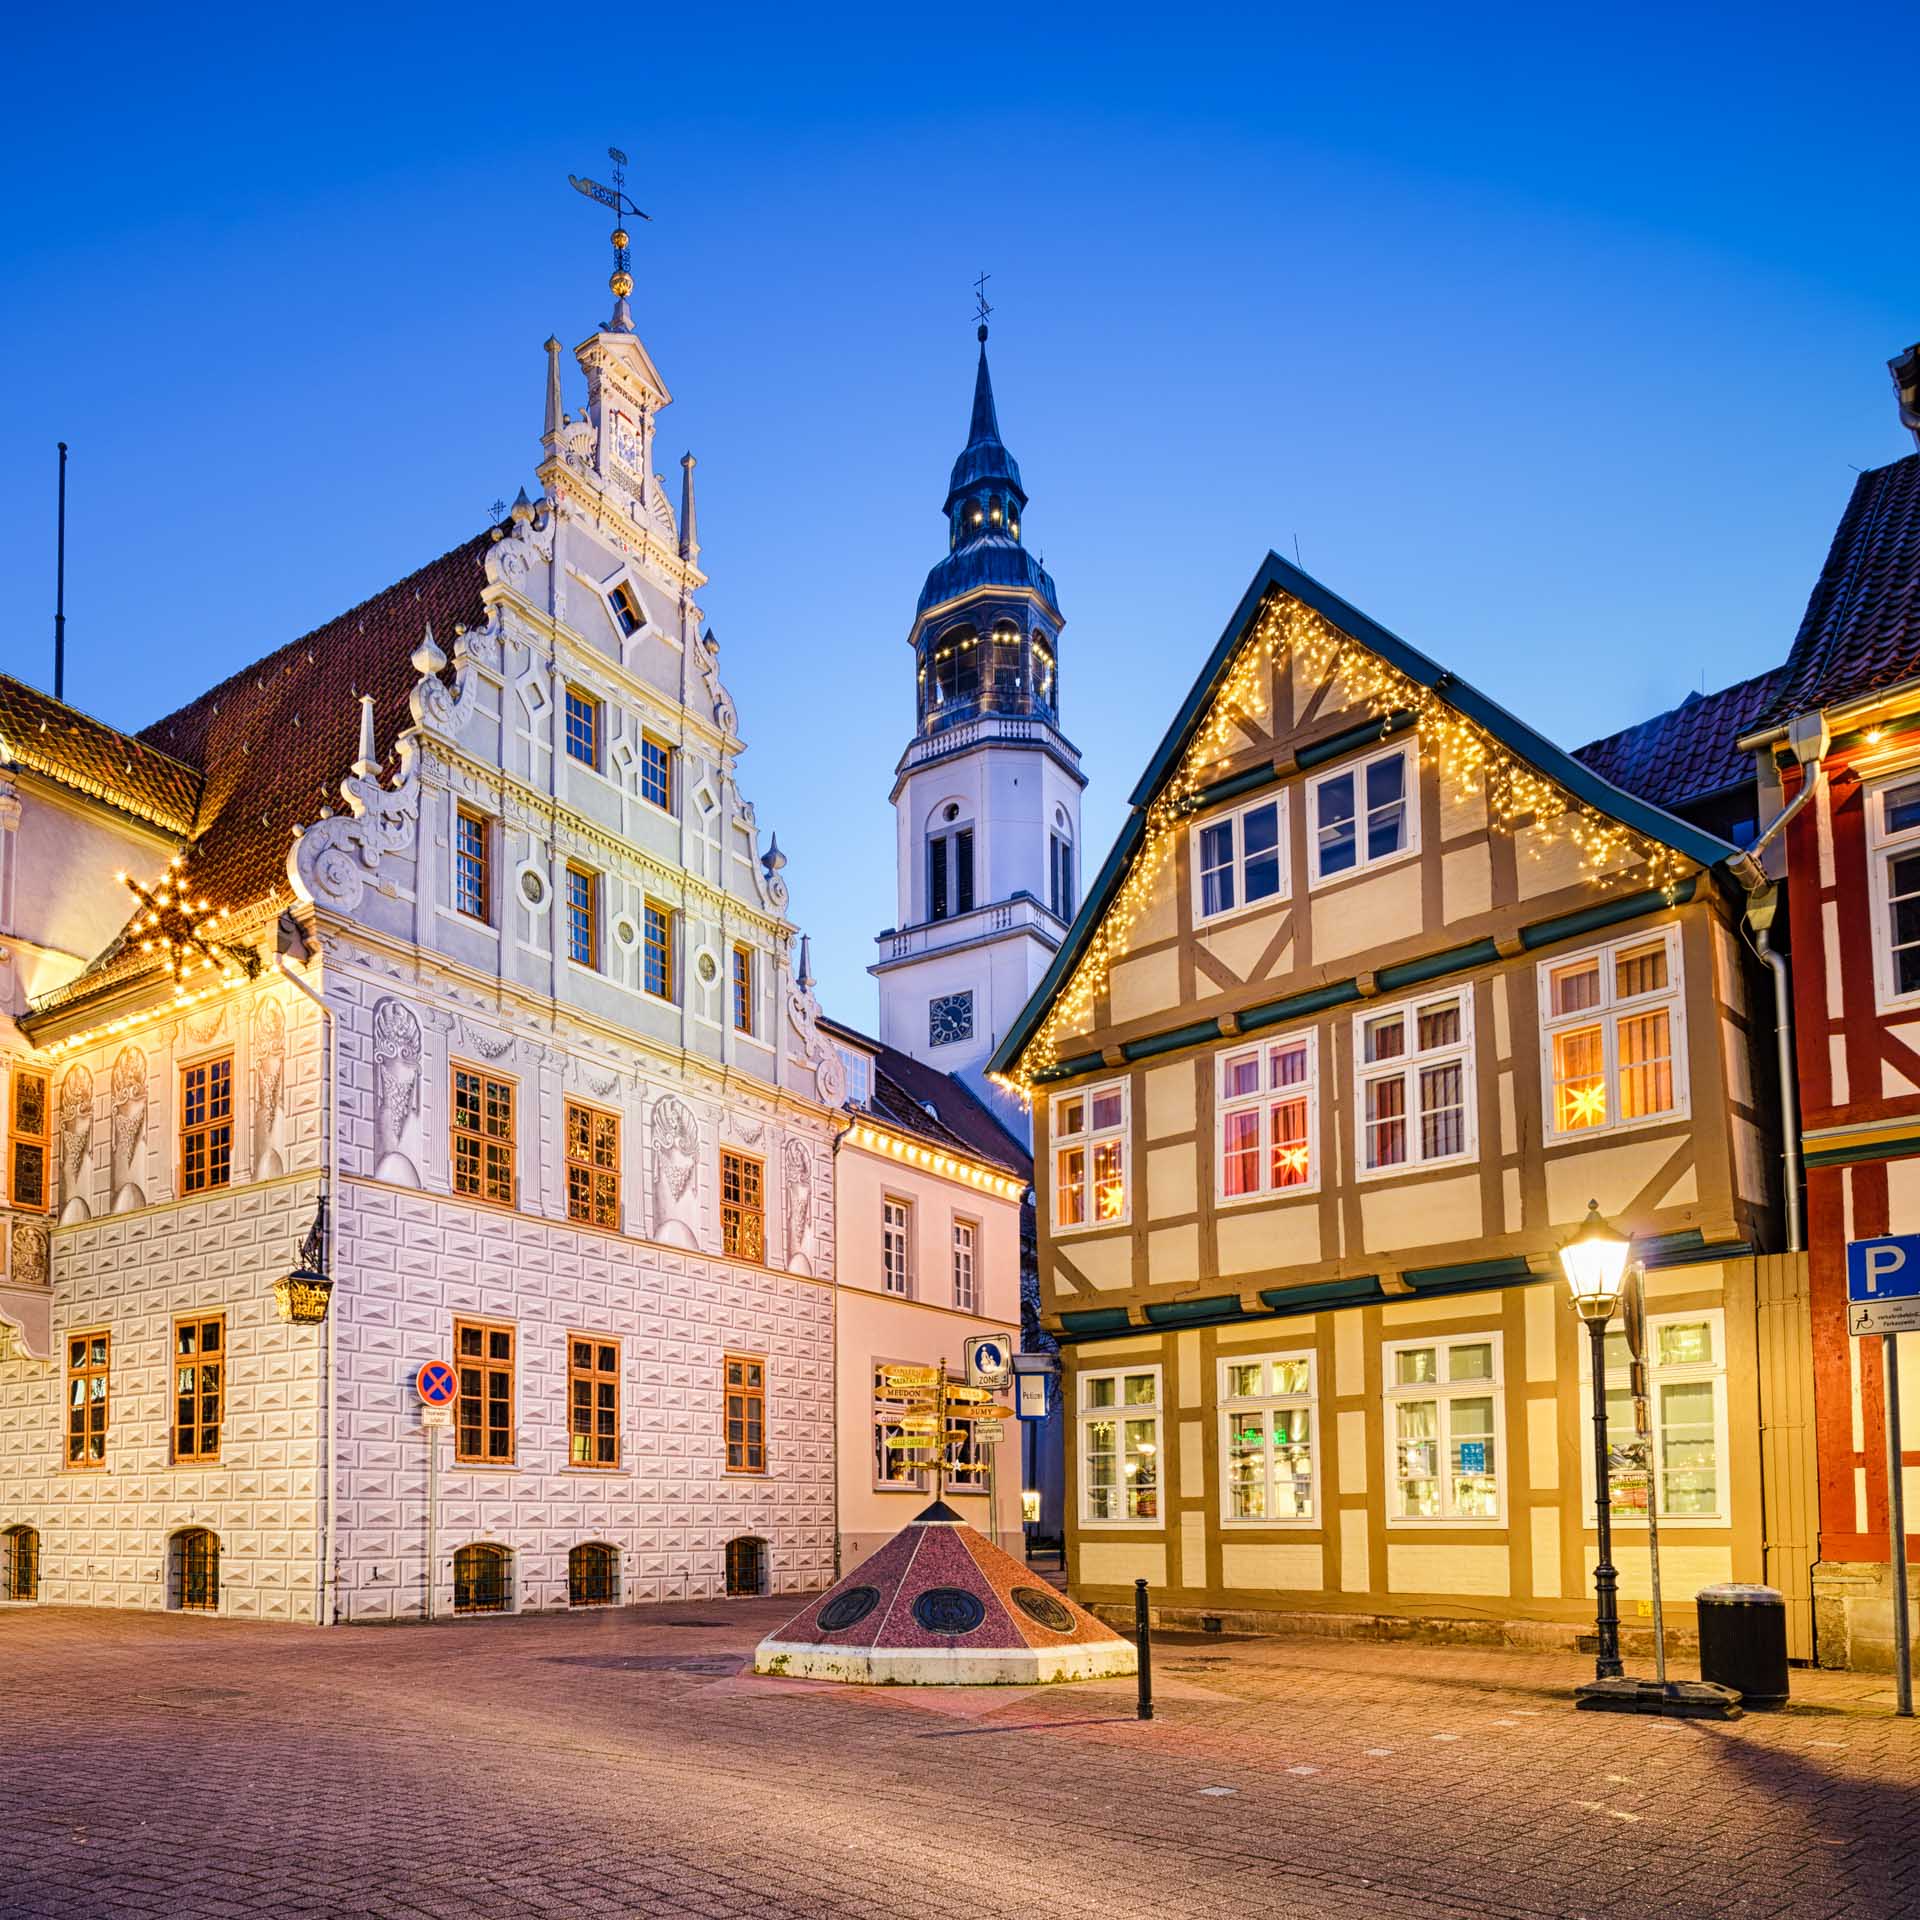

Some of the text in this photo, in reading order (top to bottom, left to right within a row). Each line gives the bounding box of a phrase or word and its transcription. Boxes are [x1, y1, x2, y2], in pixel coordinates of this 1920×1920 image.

[1866, 1246, 1905, 1292] P
[978, 1376, 999, 1385] ZONE
[887, 1389, 921, 1397] MEUDON
[970, 1408, 993, 1416] SUMY
